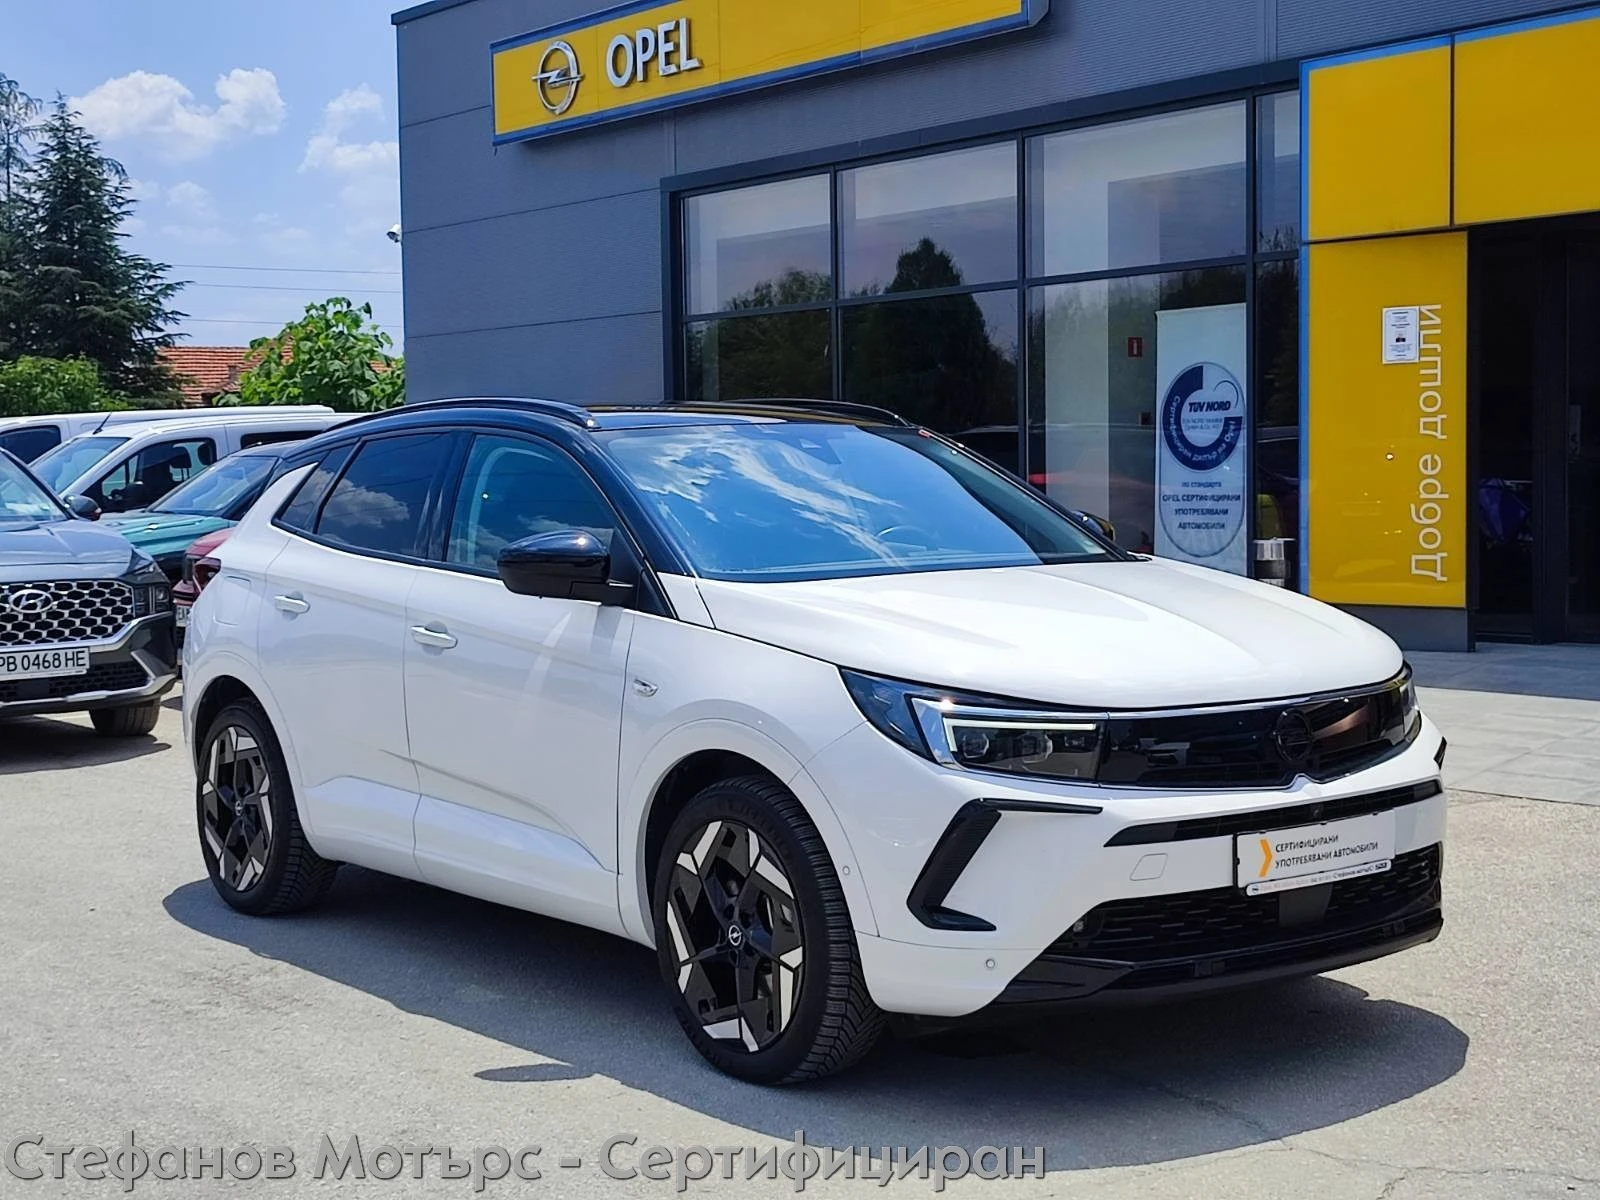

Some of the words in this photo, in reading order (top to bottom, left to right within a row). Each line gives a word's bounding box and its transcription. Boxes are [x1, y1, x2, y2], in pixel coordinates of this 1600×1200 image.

[606, 17, 702, 88] OPEL
[1419, 304, 1447, 440] дошли
[1205, 400, 1231, 412] NORD
[1411, 453, 1449, 581] Добре
[21, 652, 61, 671] 0468
[64, 650, 86, 667] HE
[1274, 851, 1332, 869] УПОТРЕБЯВАНИ
[1333, 841, 1379, 858] АВТОМОБИЛИ
[1275, 834, 1339, 853] СЕРТИФИЦИРАНИ
